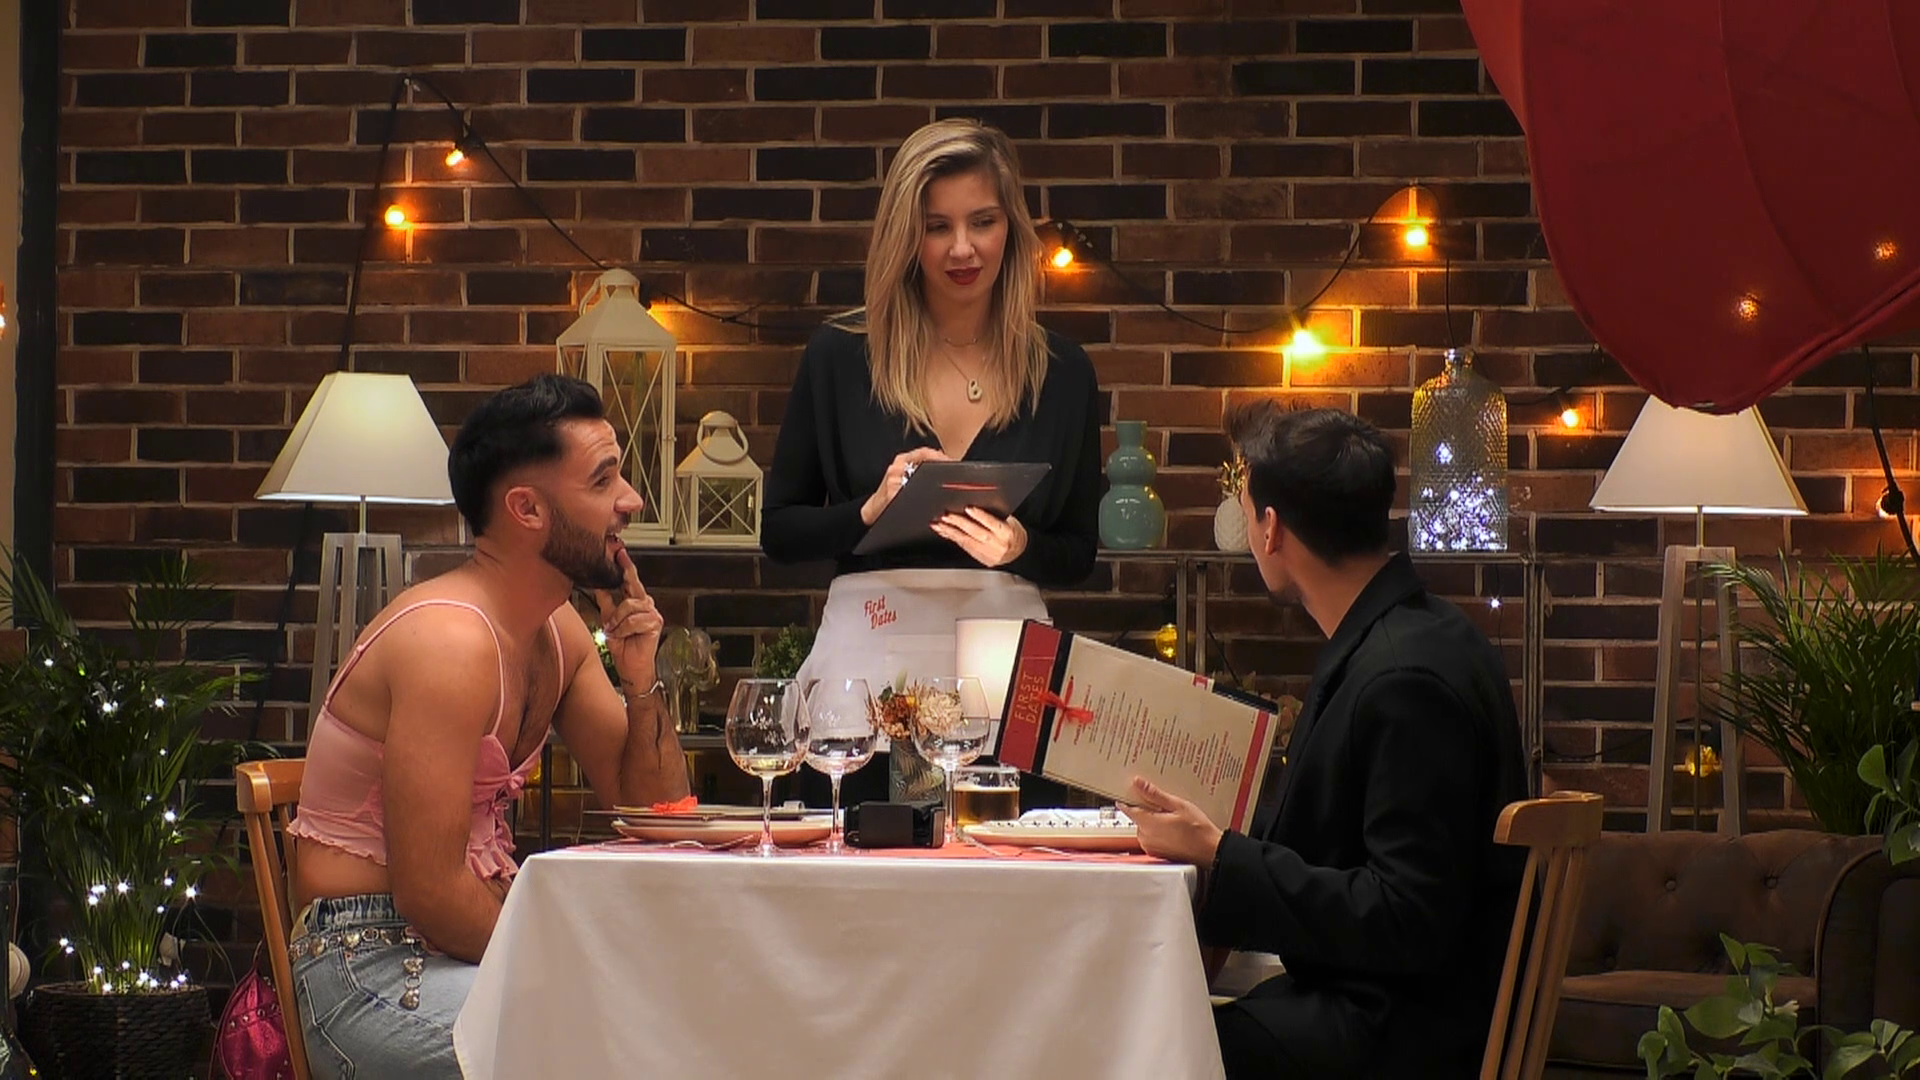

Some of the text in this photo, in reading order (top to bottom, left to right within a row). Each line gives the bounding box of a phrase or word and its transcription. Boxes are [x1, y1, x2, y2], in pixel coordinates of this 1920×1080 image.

[871, 609, 897, 630] Dates
[1014, 671, 1034, 720] FIRST
[1025, 676, 1045, 724] DATES
